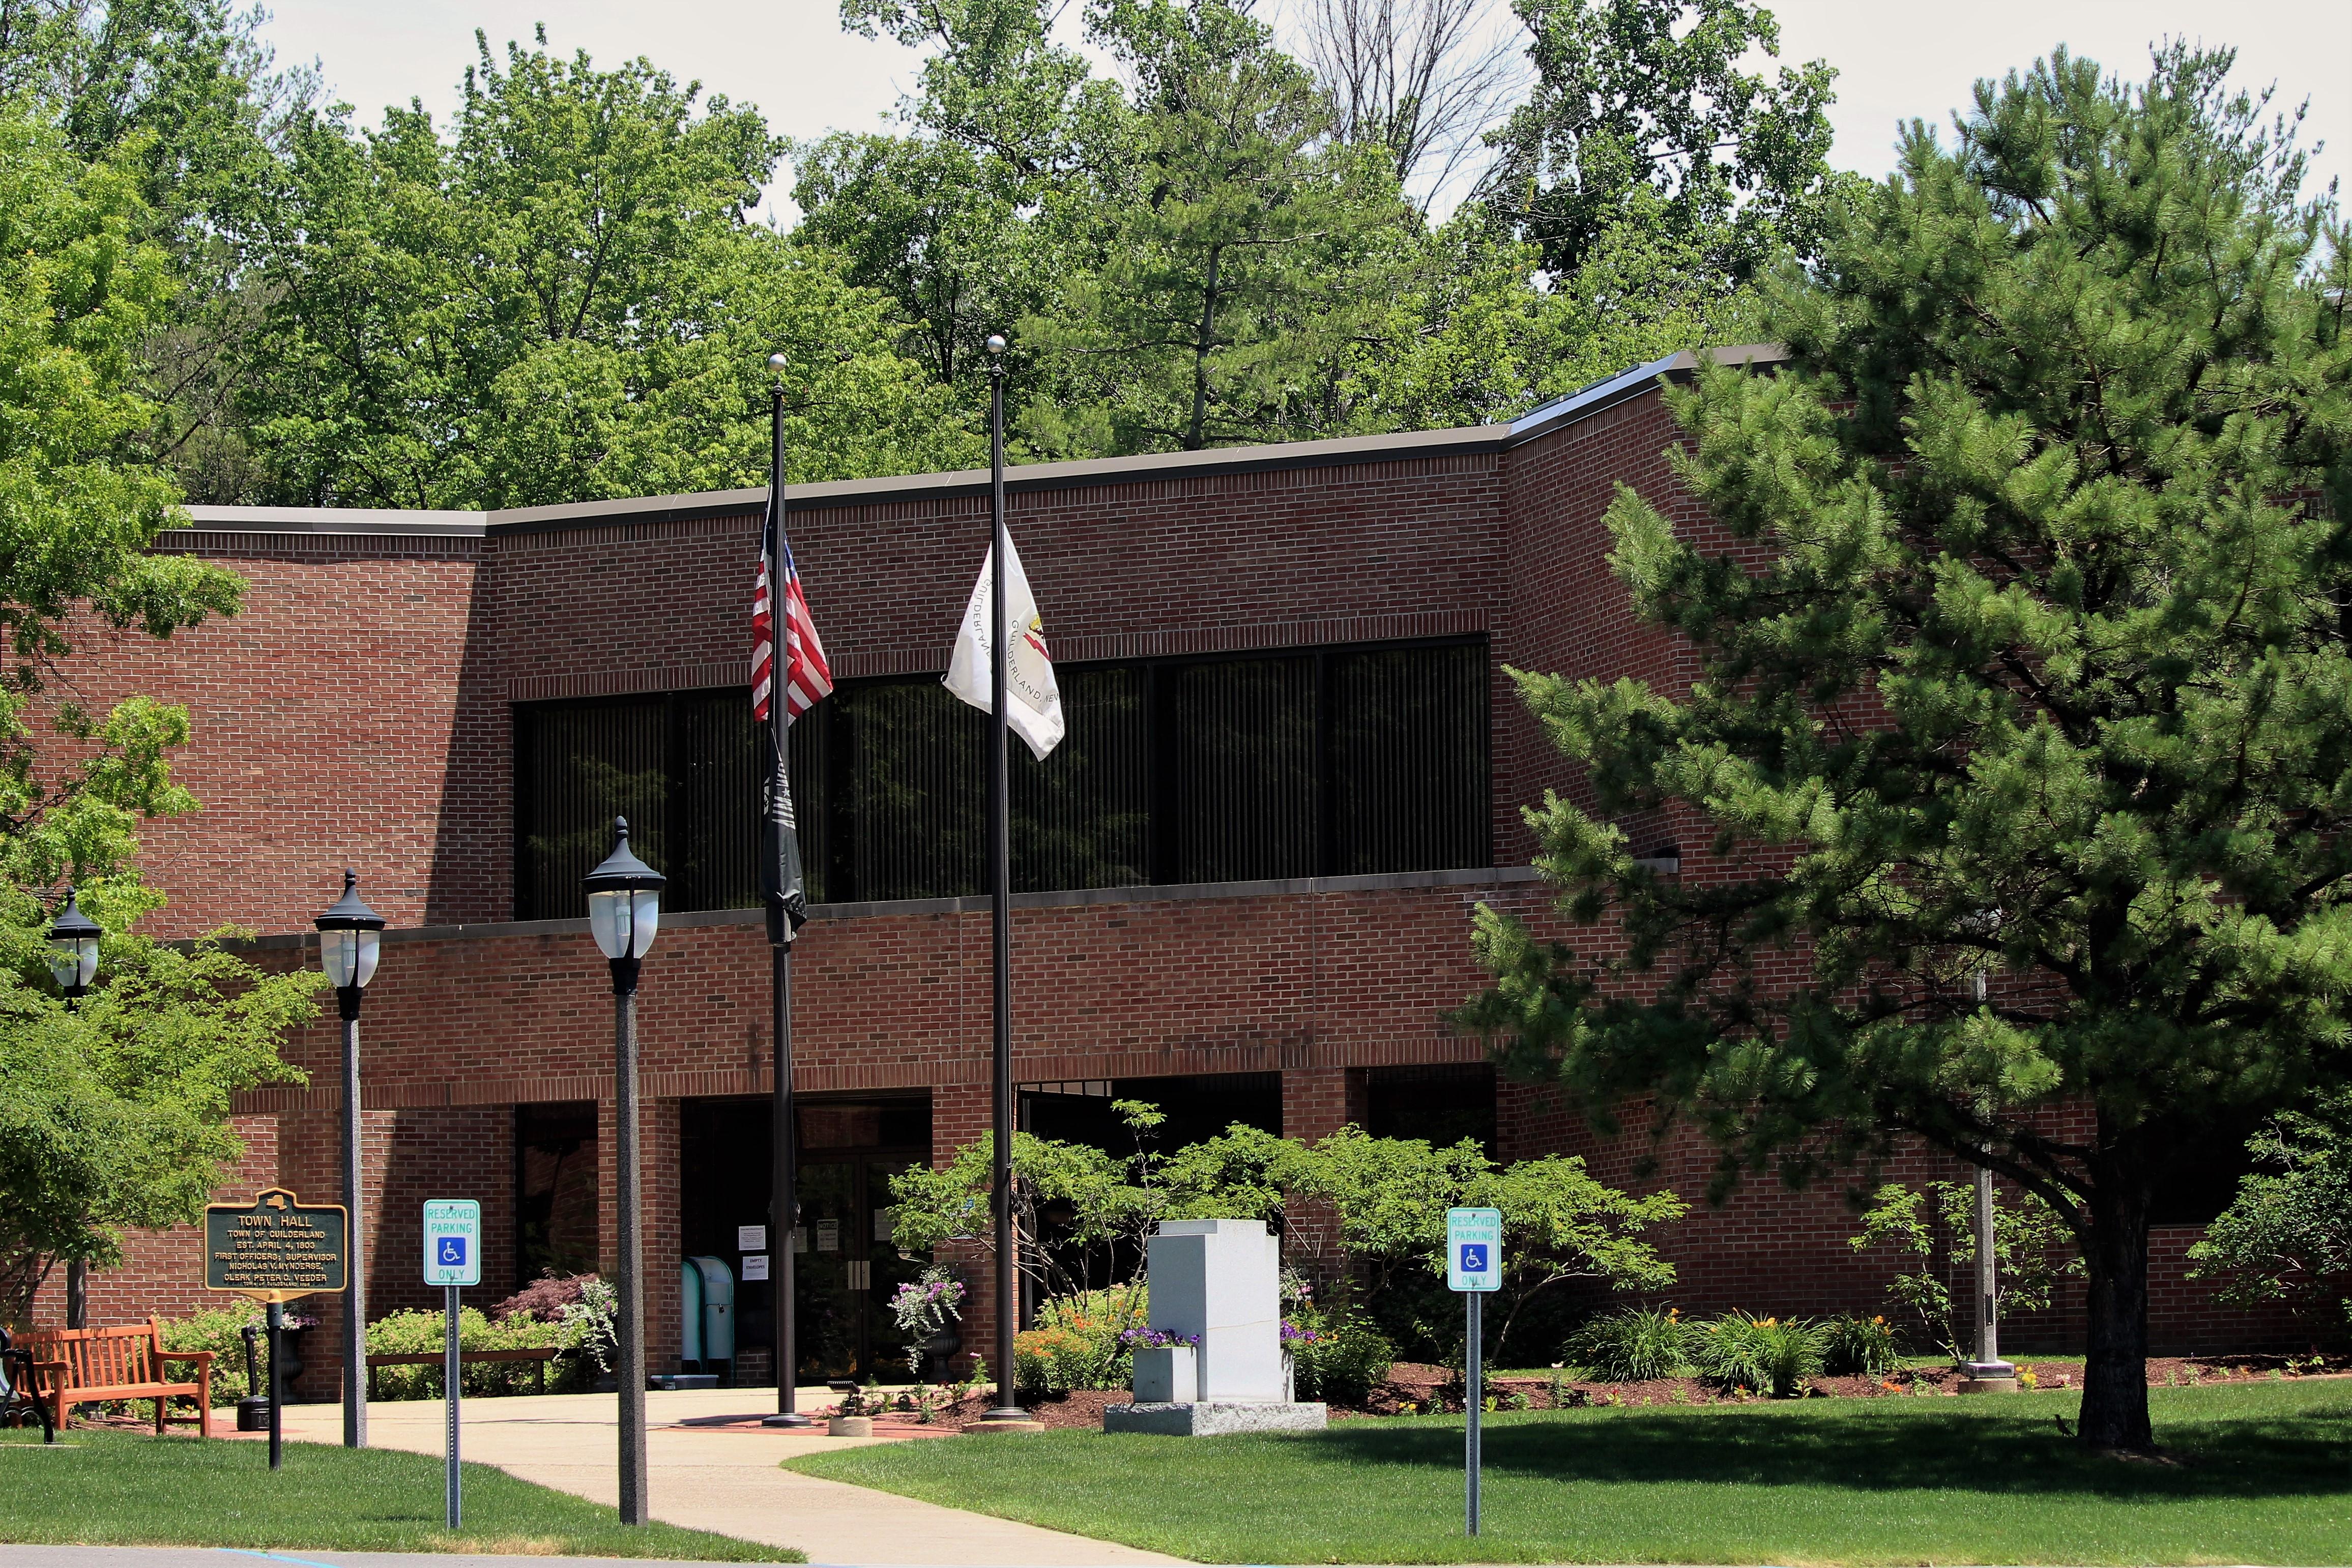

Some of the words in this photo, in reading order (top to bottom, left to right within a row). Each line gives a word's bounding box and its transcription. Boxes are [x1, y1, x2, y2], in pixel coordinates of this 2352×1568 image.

[428, 1209, 475, 1219] RESERVED
[238, 1215, 272, 1227] TOWN
[281, 1215, 312, 1227] HALL
[1451, 1216, 1496, 1227] RESERVED
[431, 1223, 472, 1234] PARKING
[270, 1230, 325, 1238] GUILDERLAND
[1455, 1230, 1493, 1240] PARKING
[285, 1241, 294, 1250] 4,
[215, 1252, 238, 1260] FIRST
[285, 1253, 336, 1261] SUPERVISOR
[278, 1262, 324, 1271] MYNDERSE,
[439, 1268, 465, 1280] ONLY
[1462, 1275, 1487, 1286] ONLY
